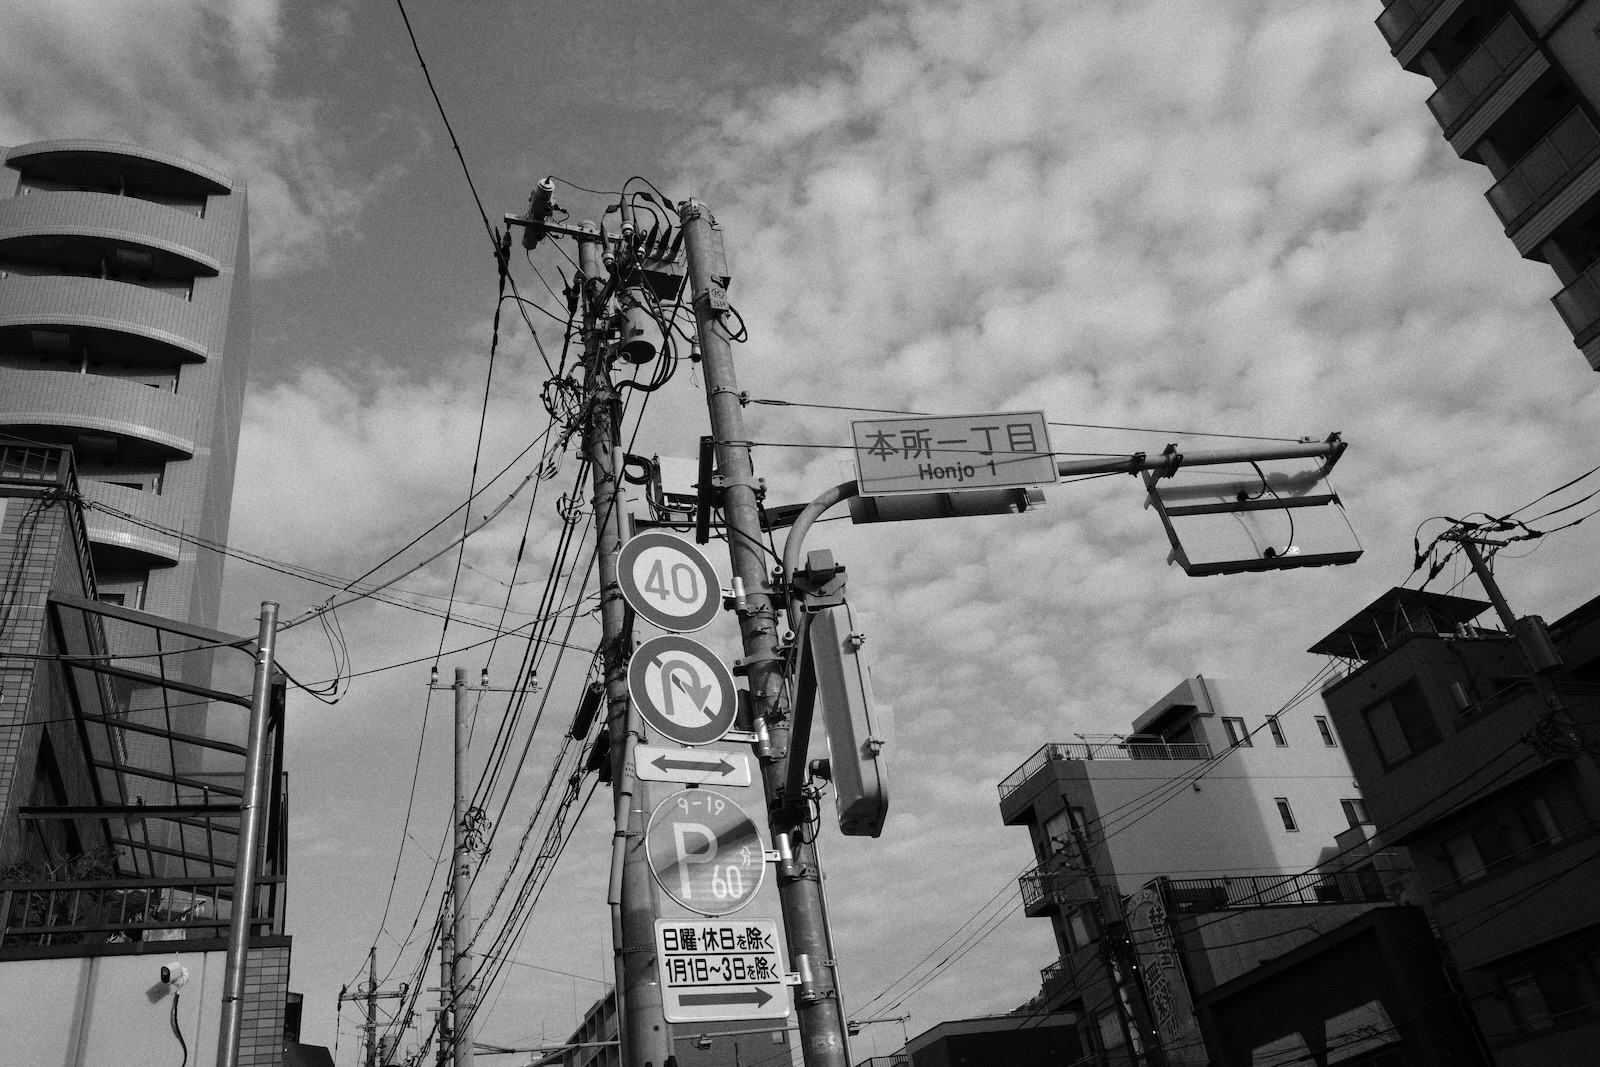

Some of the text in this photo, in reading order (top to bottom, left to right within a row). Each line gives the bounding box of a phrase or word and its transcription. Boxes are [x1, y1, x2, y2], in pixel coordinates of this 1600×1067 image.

[865, 423, 1037, 461] 本所一丁目
[918, 460, 997, 482] Honjo 1
[644, 559, 698, 604] 40
[677, 795, 725, 816] 9-19
[673, 822, 718, 899] P
[663, 927, 774, 952] 日曜・休日を除く
